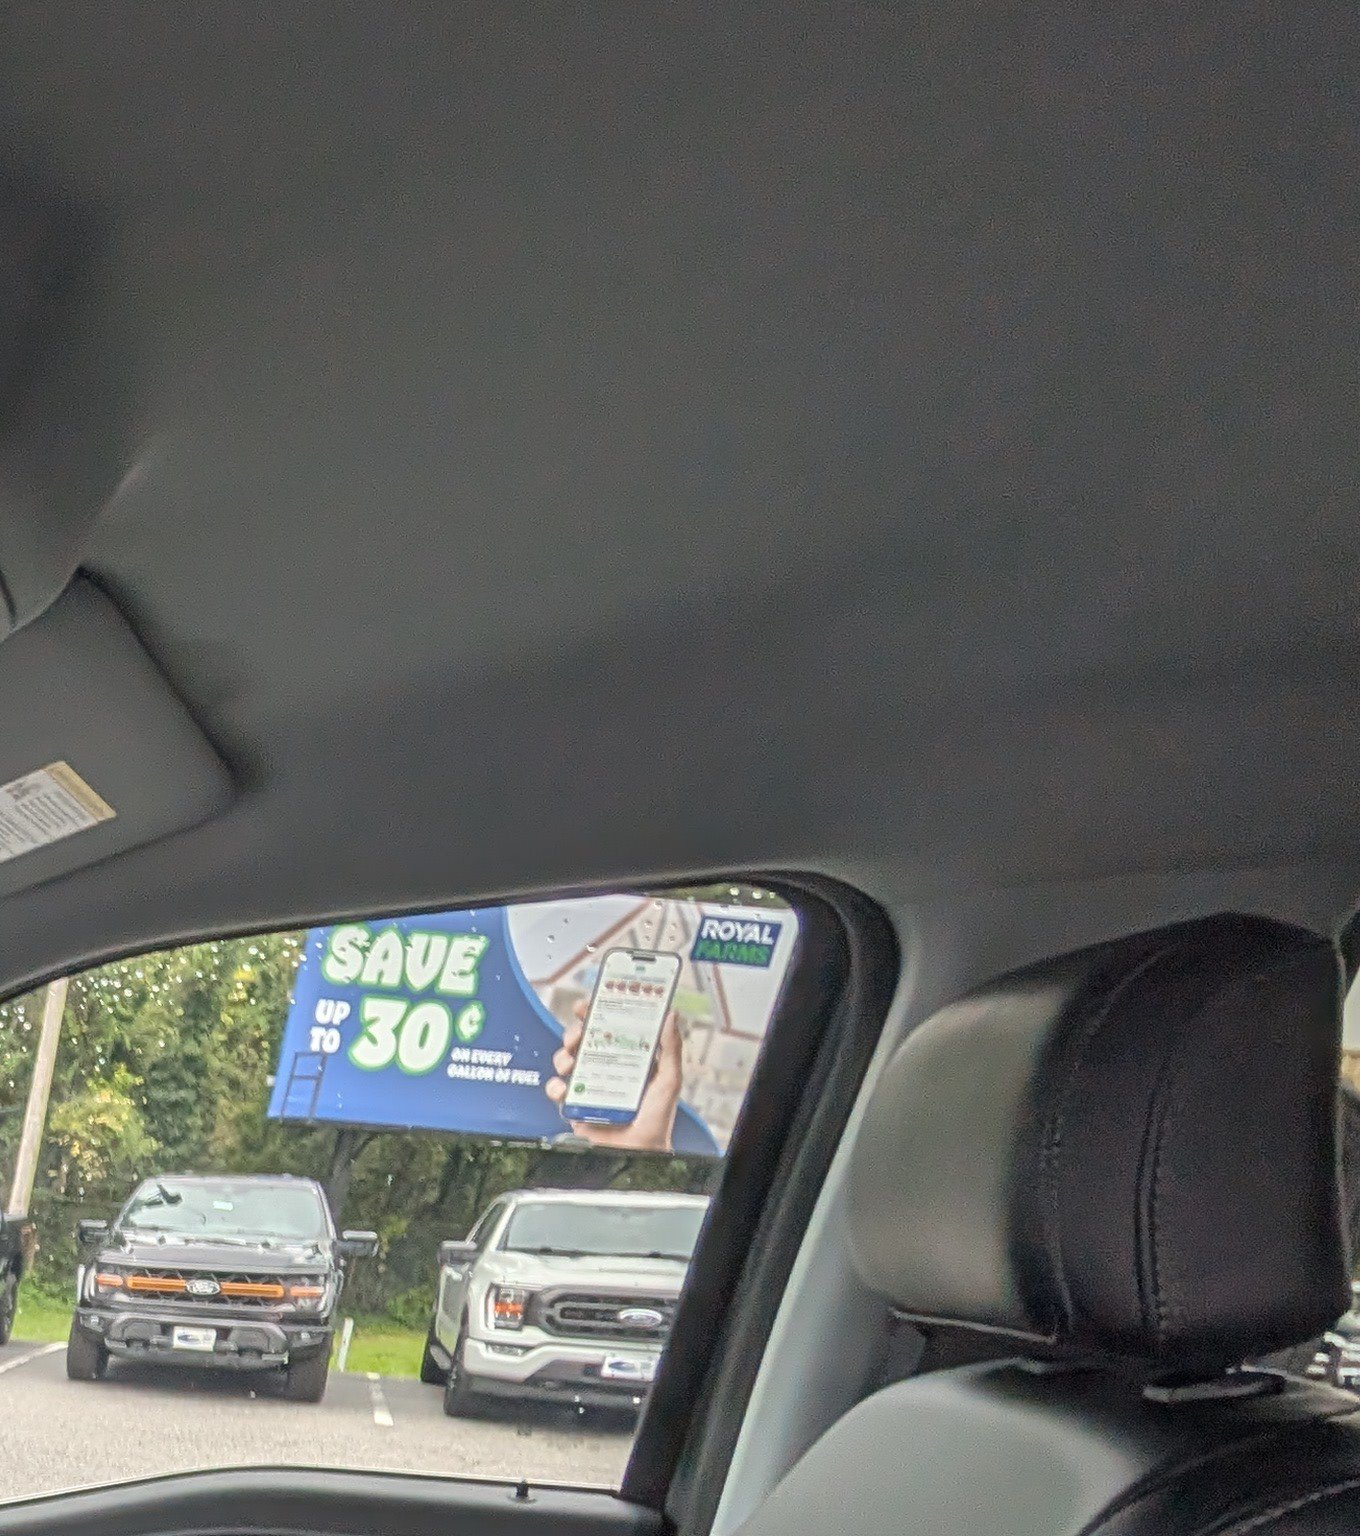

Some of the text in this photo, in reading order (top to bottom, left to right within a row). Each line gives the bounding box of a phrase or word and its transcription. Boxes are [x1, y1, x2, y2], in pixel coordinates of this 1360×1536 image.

[701, 919, 774, 945] ROYAL
[324, 922, 488, 993] SAVE
[315, 999, 351, 1025] UP
[310, 1026, 341, 1053] TO
